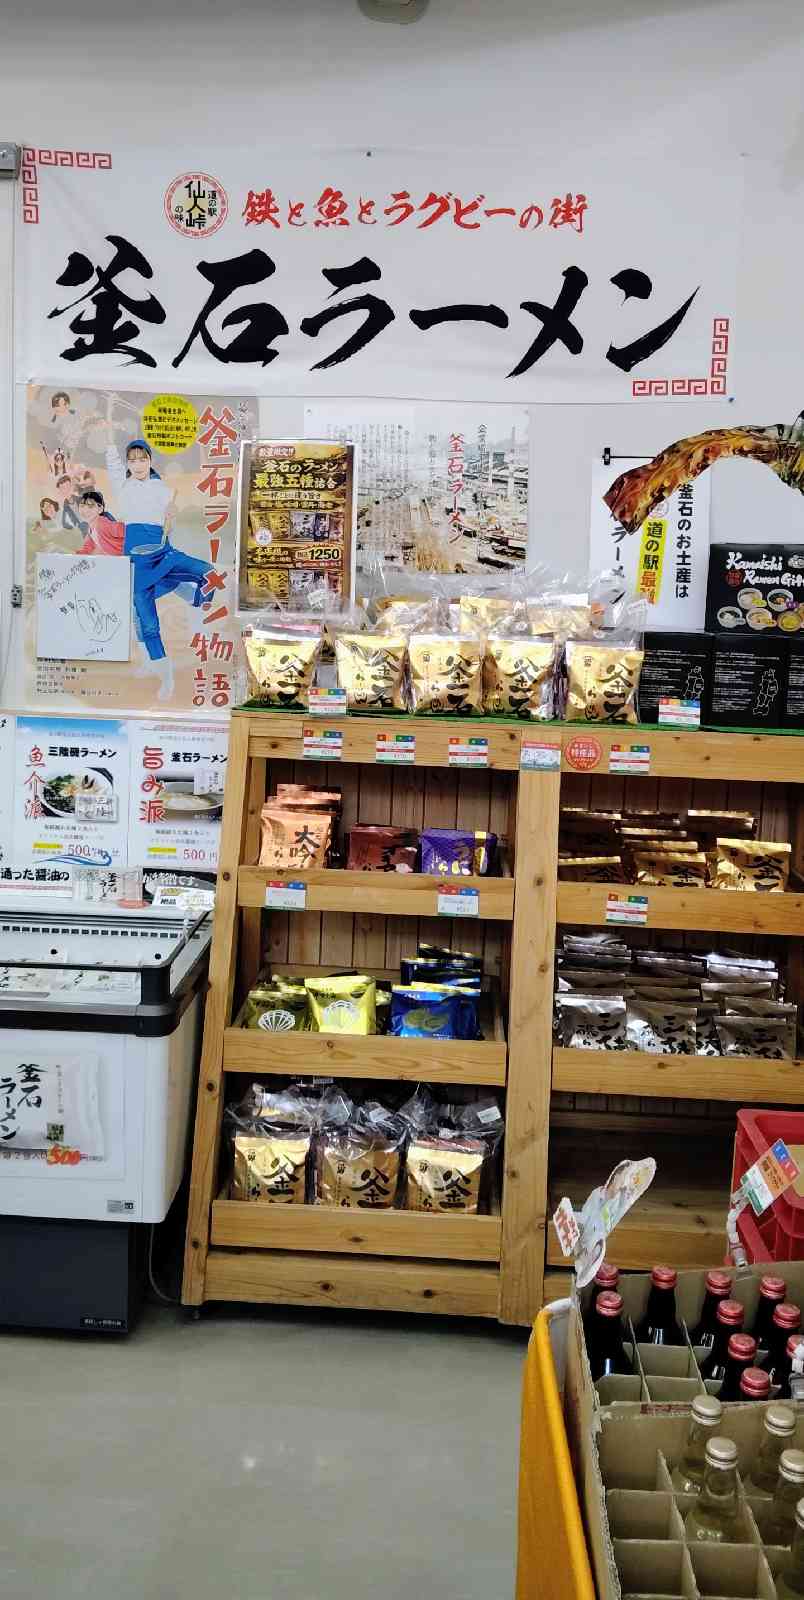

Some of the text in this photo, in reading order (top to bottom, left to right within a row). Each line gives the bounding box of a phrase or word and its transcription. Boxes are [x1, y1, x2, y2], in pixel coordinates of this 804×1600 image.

[184, 180, 206, 230] 仙人峠
[207, 190, 217, 216] 道の駅
[241, 187, 588, 233] 鉄と魚とラグビーの街
[46, 235, 700, 379] 釜石ラーメン
[447, 432, 464, 544] 釜石ラーメン
[191, 405, 238, 708] 釜石ラーメン物語
[308, 548, 340, 560] 1250
[675, 483, 694, 599] 釜石のお土産は
[725, 551, 783, 571] Kamaishi
[743, 569, 780, 586] Ramen
[780, 572, 804, 587] Gif
[171, 752, 228, 763] 釜石ラーメン
[24, 745, 46, 820] 魚介派
[139, 746, 166, 823] 旨み派
[183, 848, 206, 860] 500
[0, 1077, 18, 1140] ラーメン
[17, 1064, 48, 1108] 釜石
